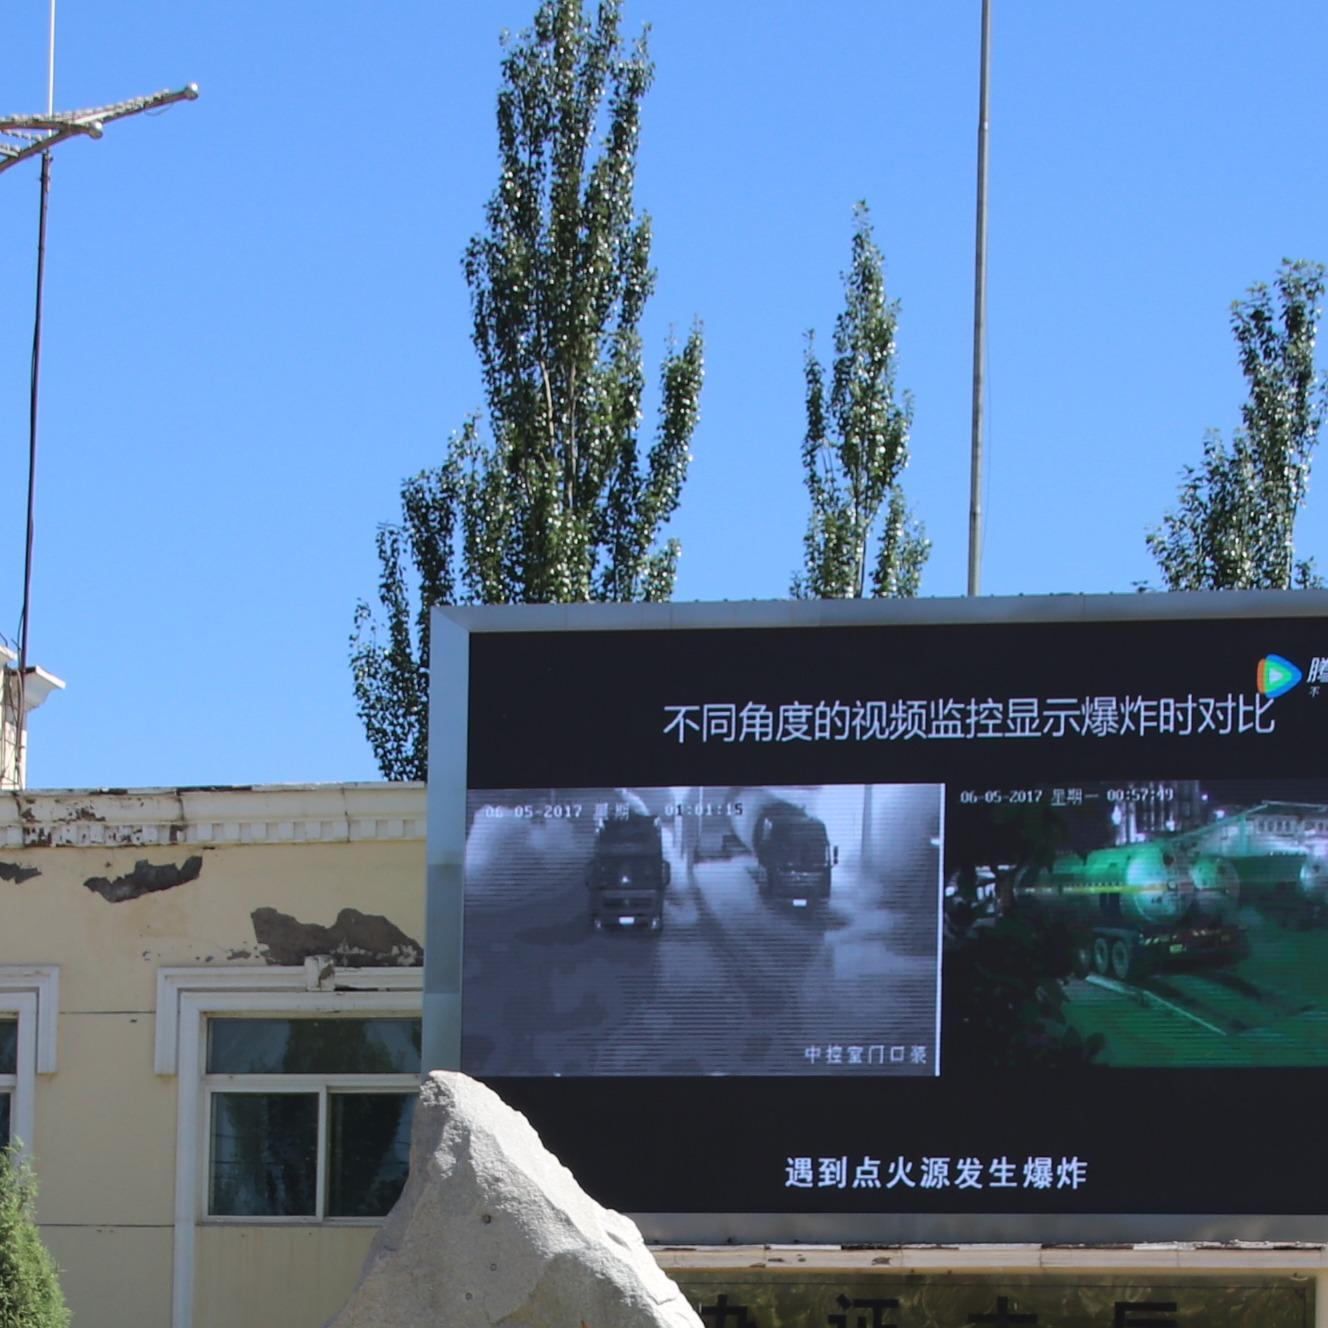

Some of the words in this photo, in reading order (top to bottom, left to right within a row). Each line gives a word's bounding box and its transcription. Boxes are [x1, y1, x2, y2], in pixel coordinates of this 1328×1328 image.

[662, 692, 1276, 743] 不同角度的视频监控显示爆炸时对比
[960, 788, 1043, 804] 06-05-2017
[485, 803, 582, 818] 0605-2017
[784, 1155, 1088, 1190] 遇到点火源发生爆炸
